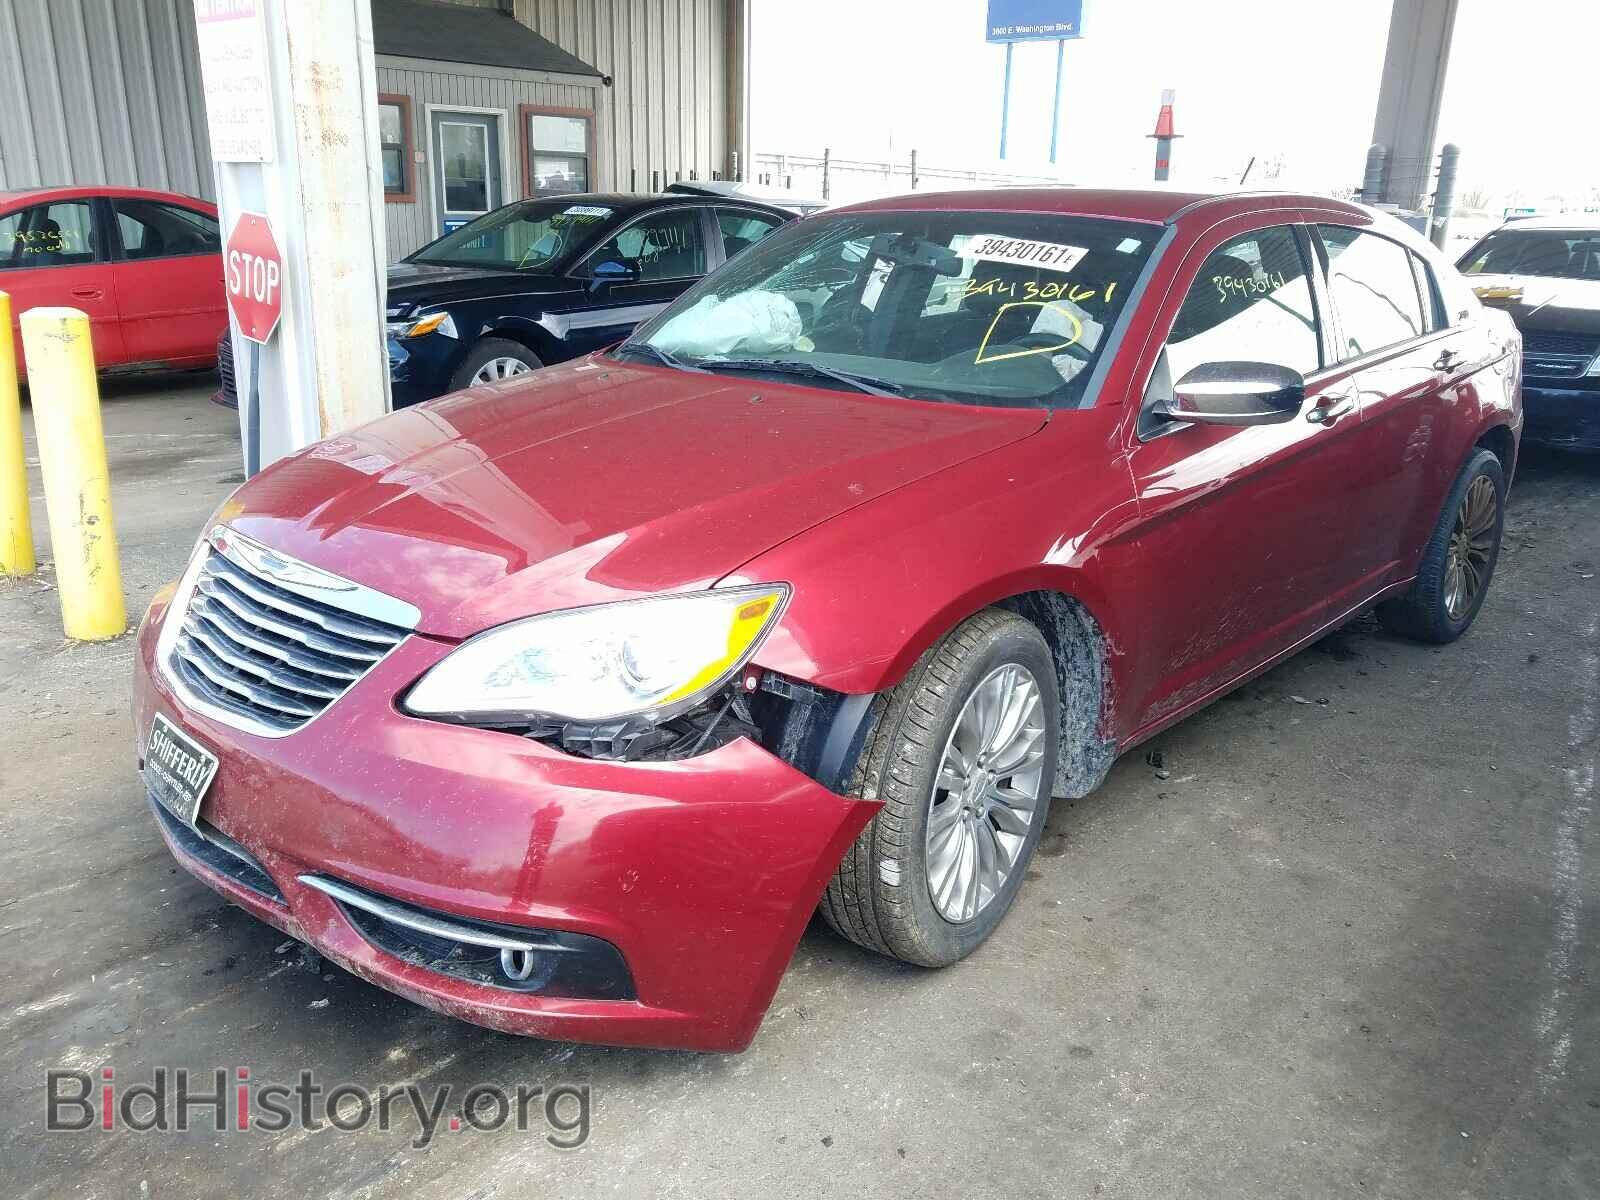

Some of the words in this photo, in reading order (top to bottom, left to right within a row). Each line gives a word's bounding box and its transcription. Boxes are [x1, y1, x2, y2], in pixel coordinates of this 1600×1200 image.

[1016, 23, 1055, 33] Washington
[229, 249, 280, 306] STOP
[1212, 271, 1285, 303] 39430161
